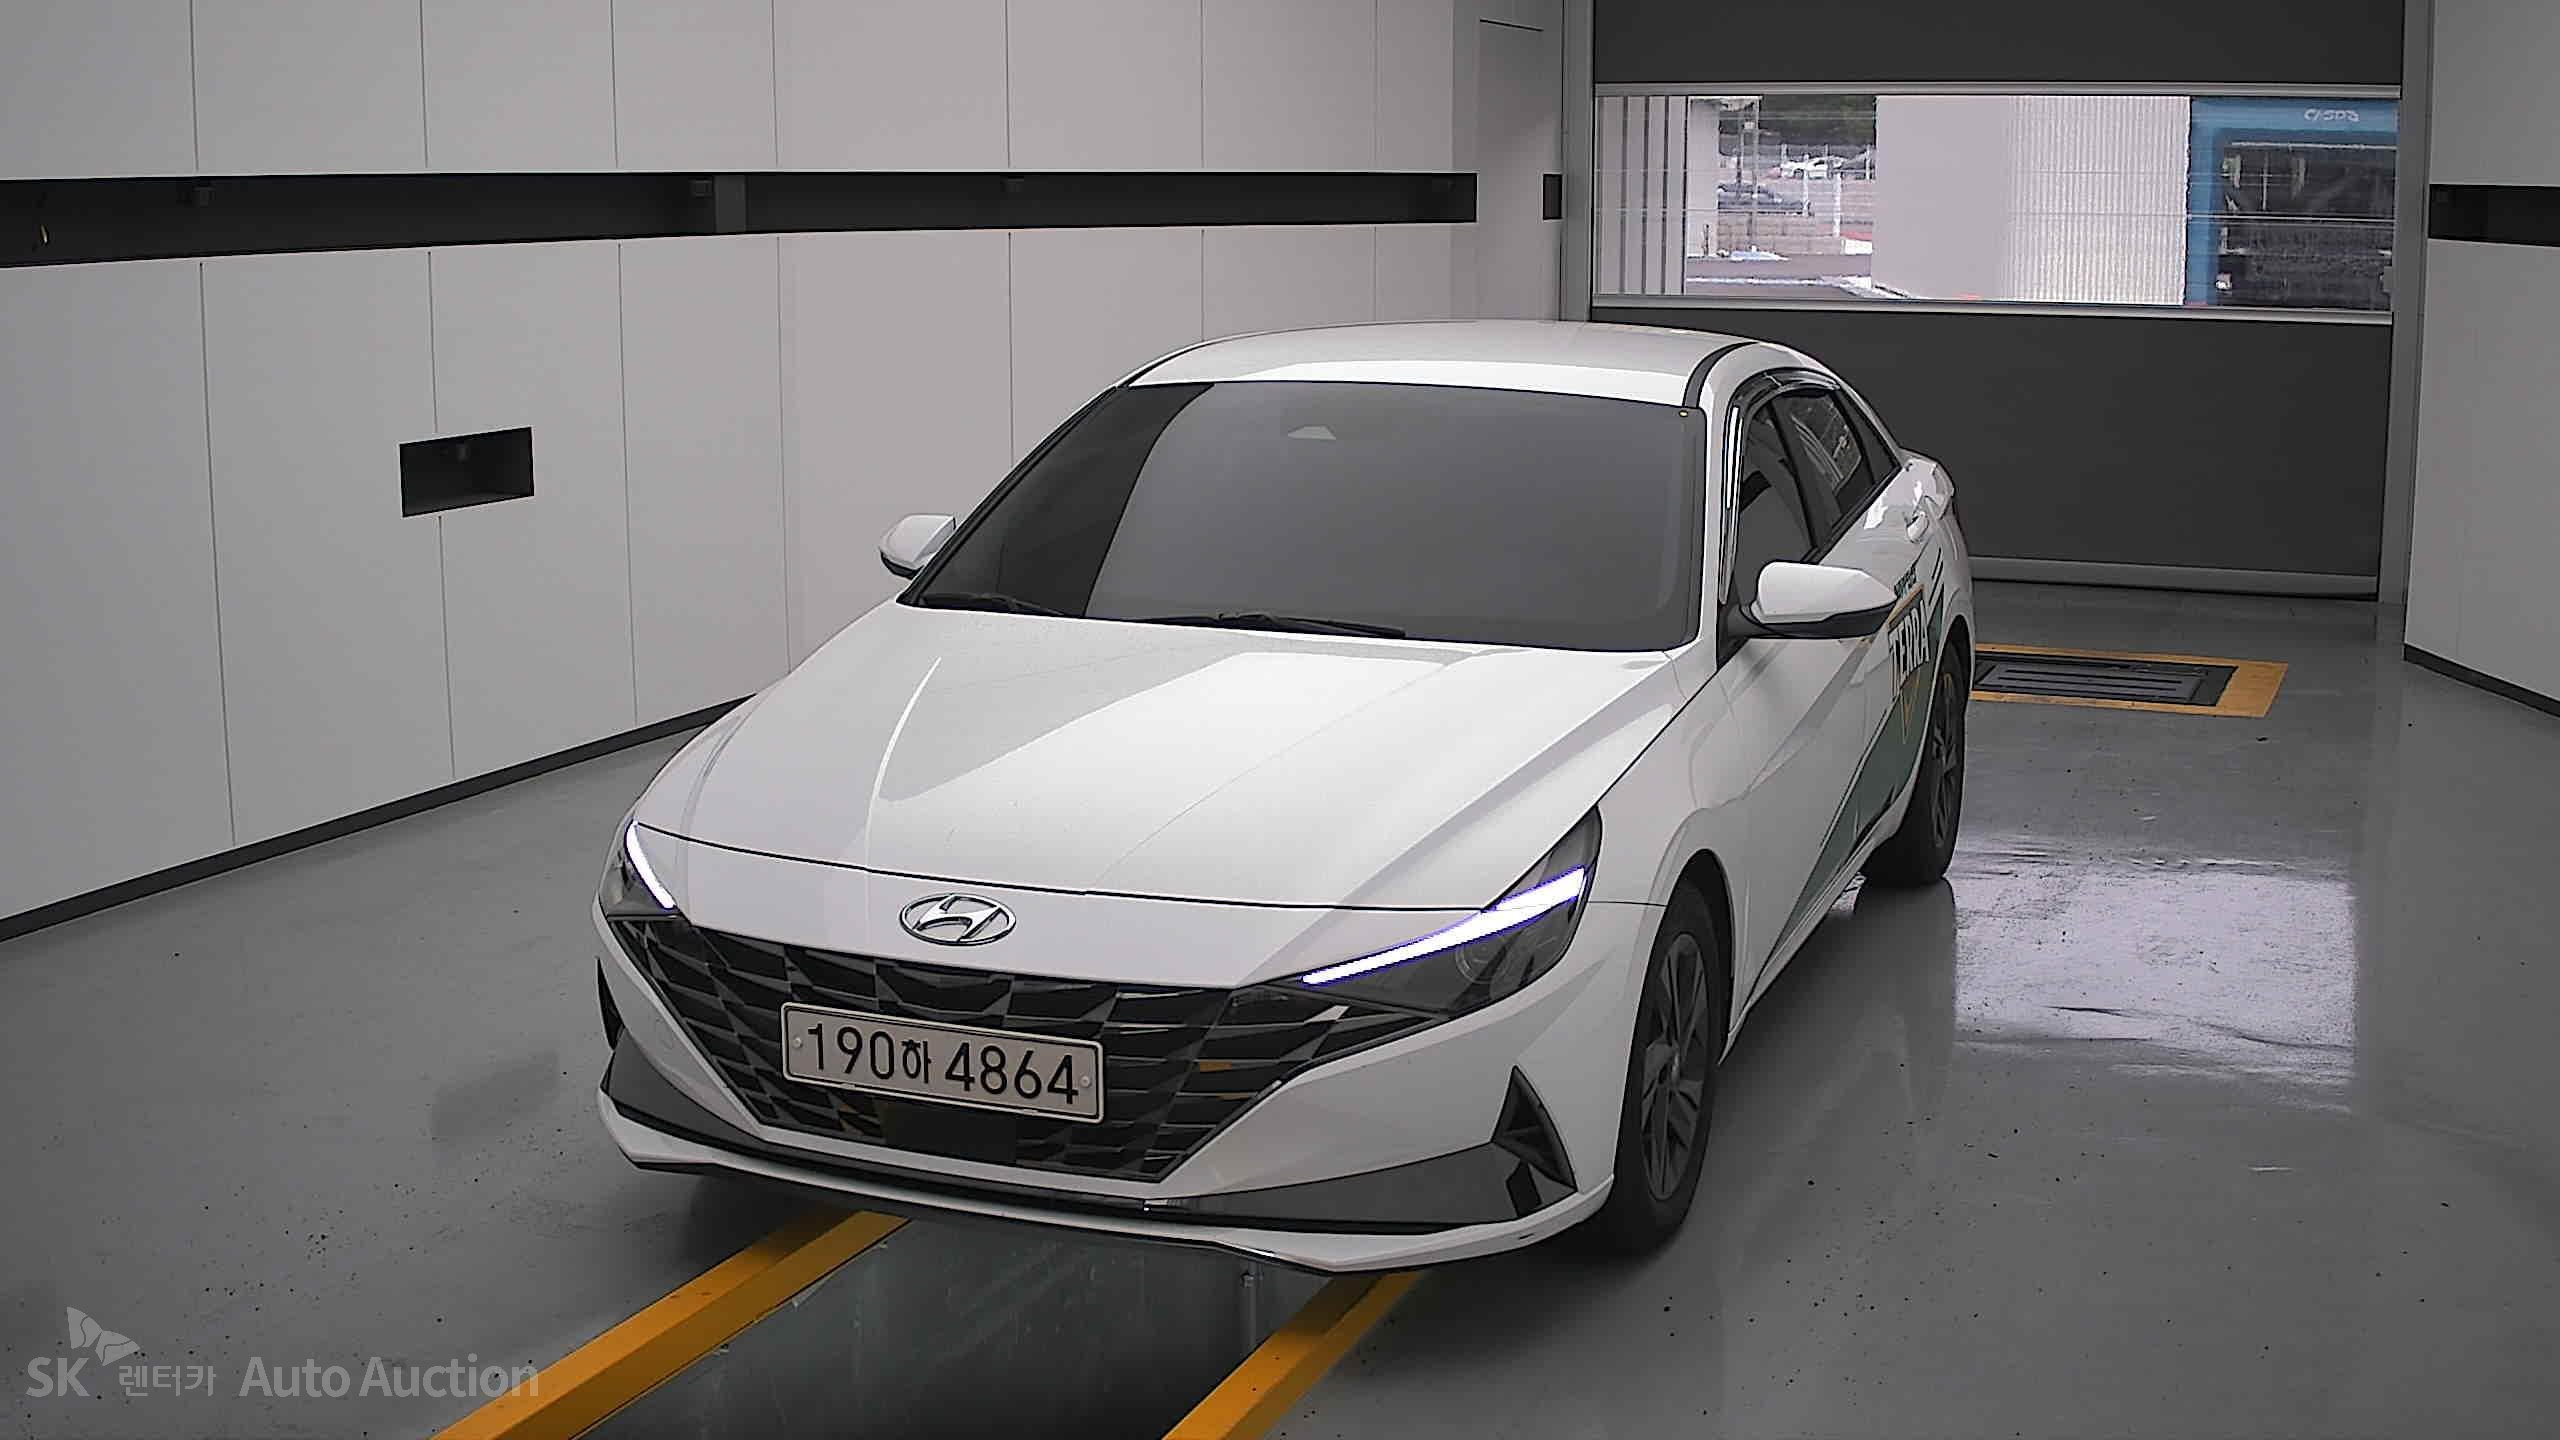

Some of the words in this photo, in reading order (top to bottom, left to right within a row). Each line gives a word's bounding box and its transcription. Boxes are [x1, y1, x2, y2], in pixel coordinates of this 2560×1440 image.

[1889, 600, 1930, 699] TERRA
[807, 1023, 932, 1084] 190하
[944, 1042, 1079, 1105] 4864
